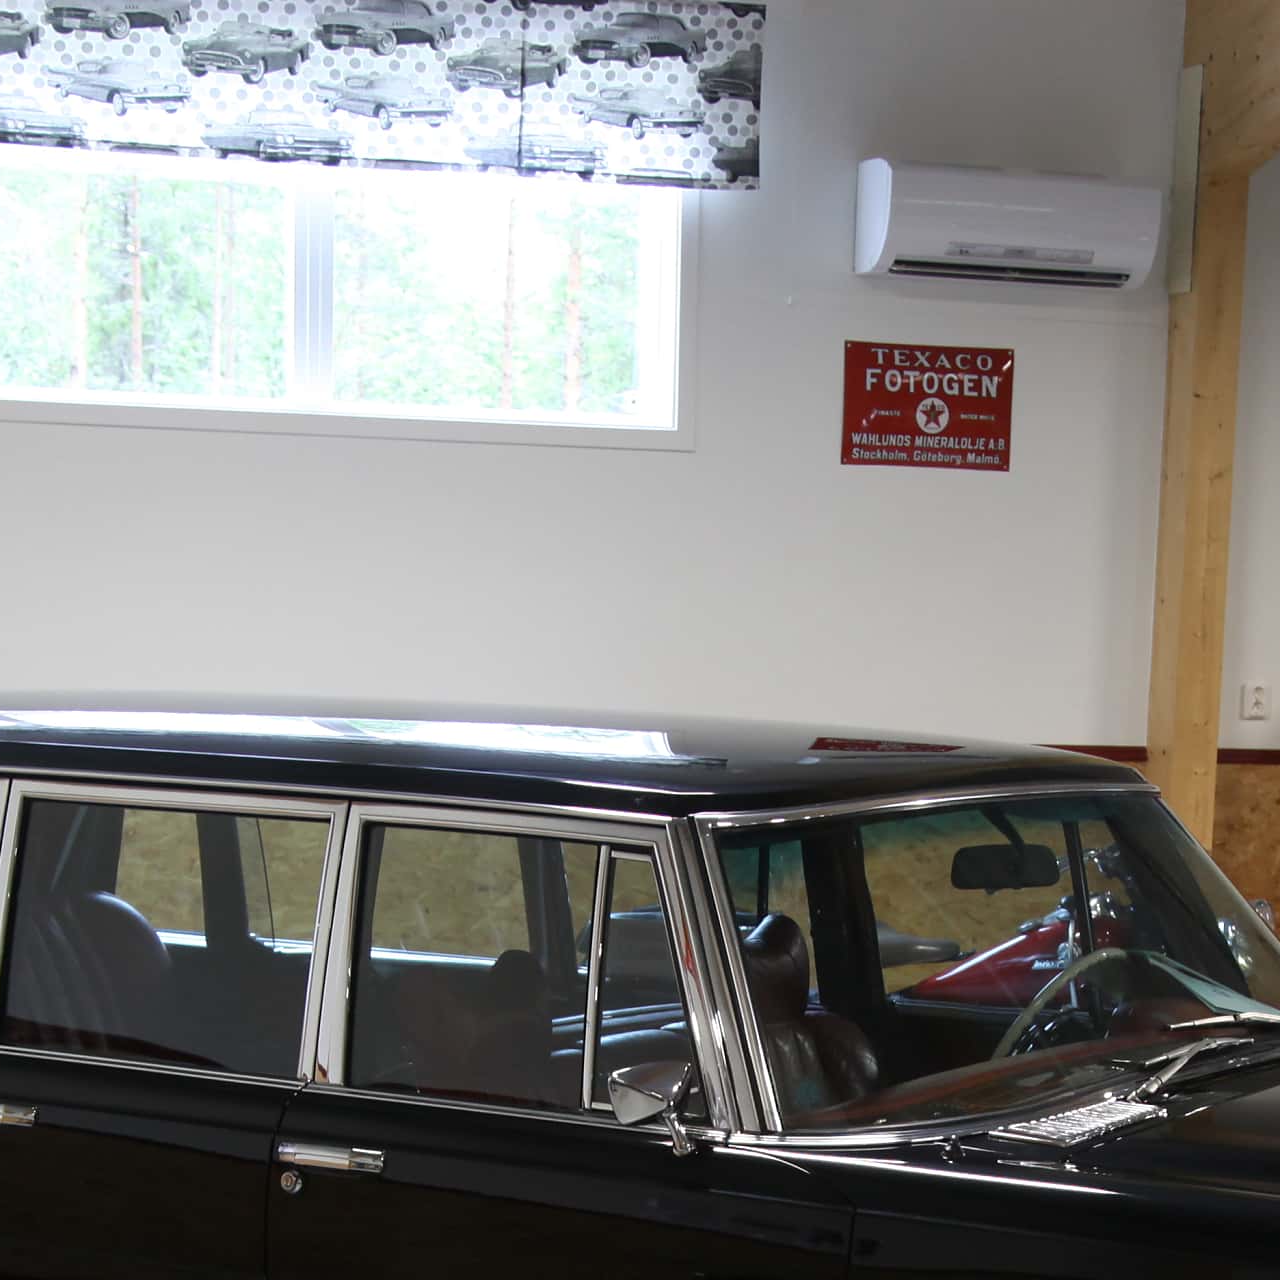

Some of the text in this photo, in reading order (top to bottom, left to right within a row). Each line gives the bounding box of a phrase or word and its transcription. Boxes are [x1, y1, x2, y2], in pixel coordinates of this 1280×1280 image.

[871, 348, 993, 371] TEXACO
[865, 368, 1000, 398] FOTOGEN
[851, 432, 911, 447] WAHLUNDS
[915, 436, 986, 449] MINERALOLJE
